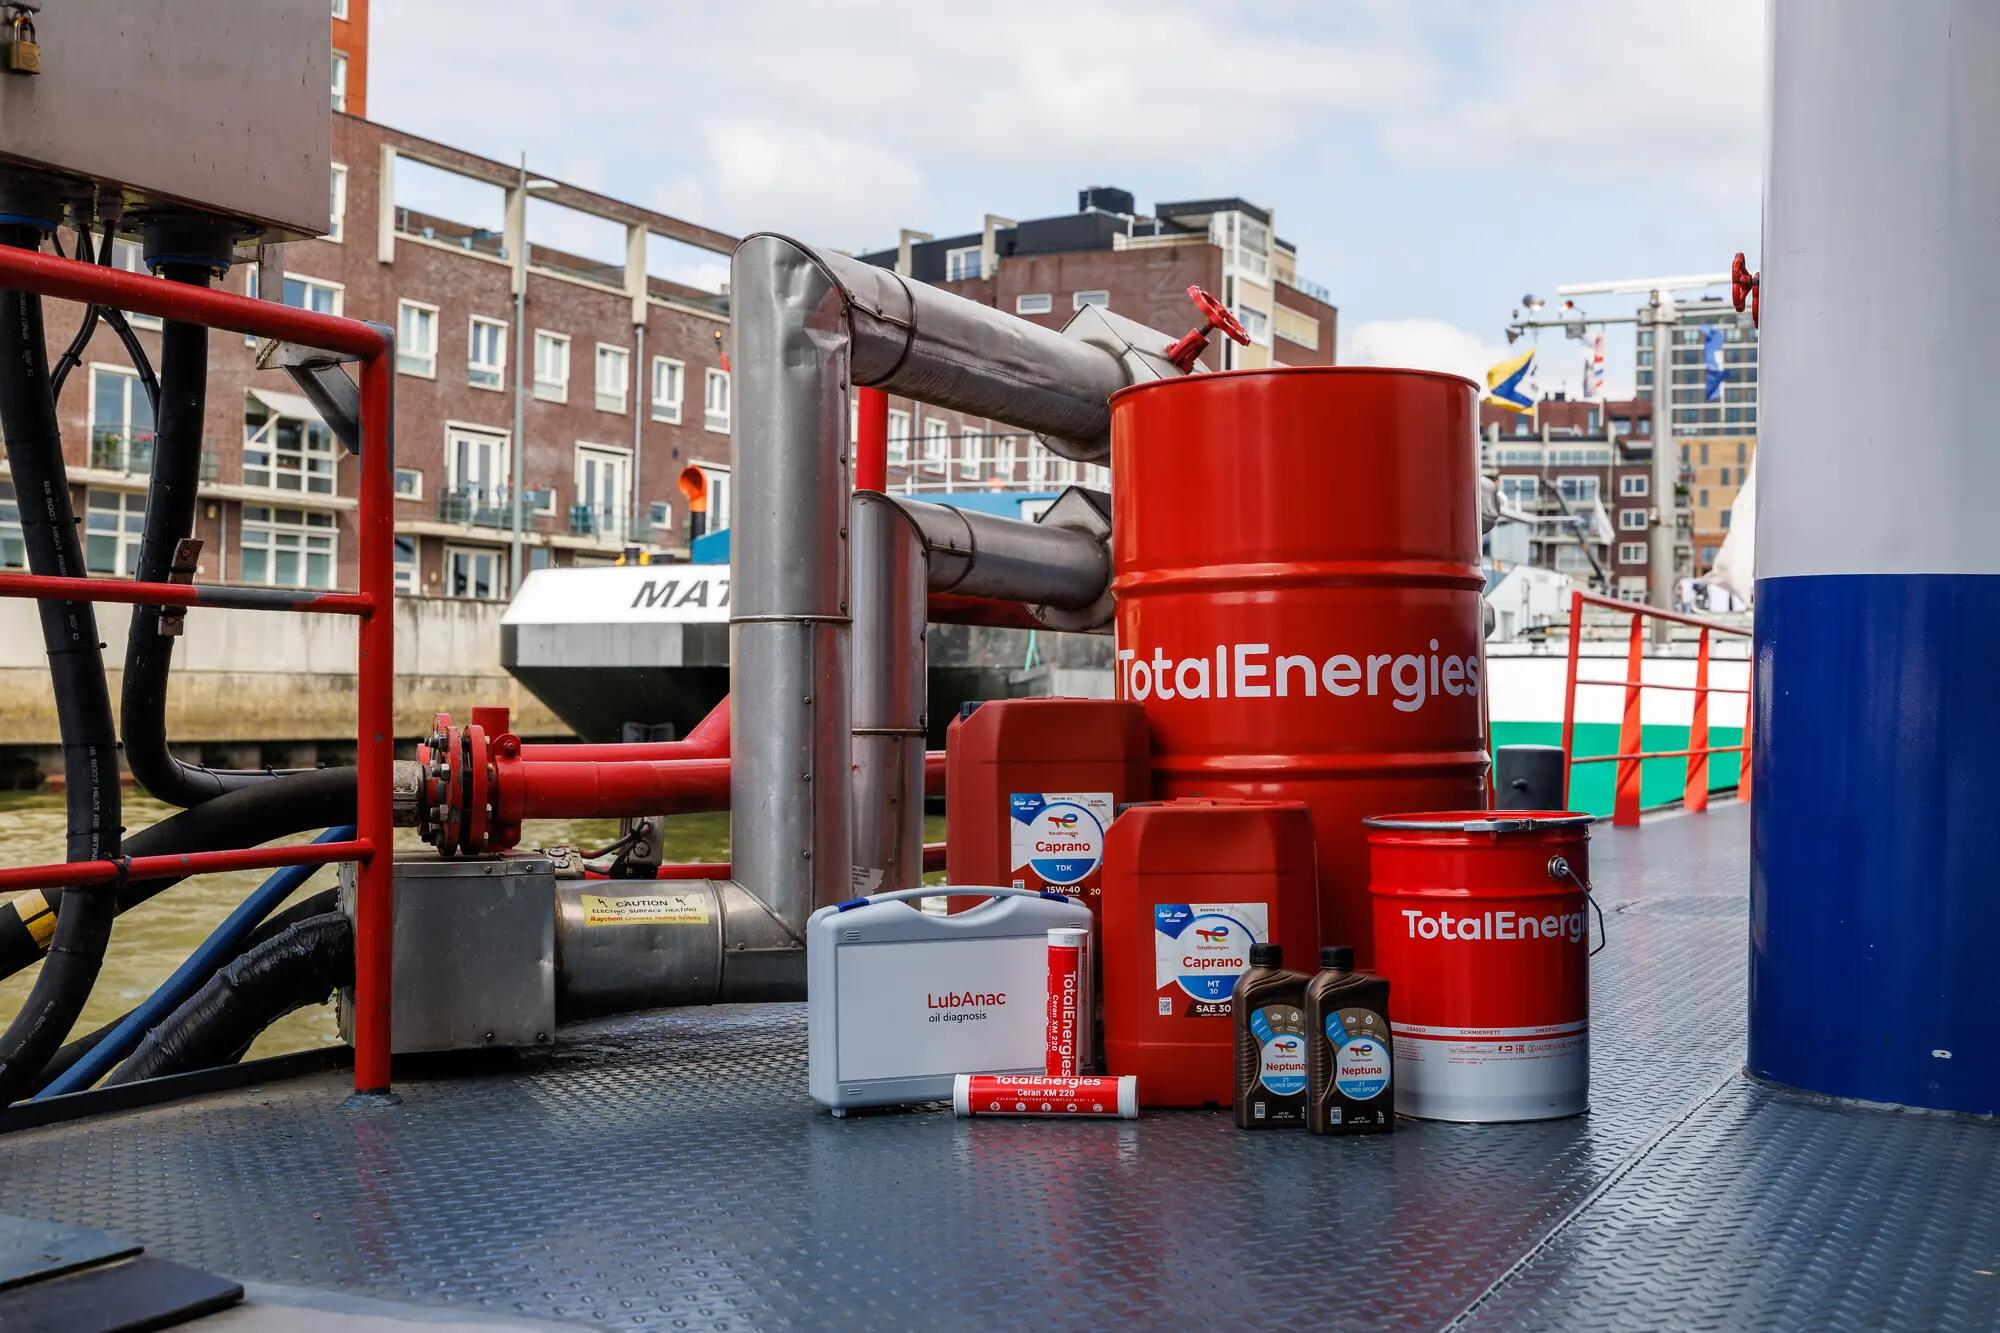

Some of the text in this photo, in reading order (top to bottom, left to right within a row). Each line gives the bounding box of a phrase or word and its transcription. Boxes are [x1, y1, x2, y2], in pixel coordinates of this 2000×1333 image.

[1119, 638, 1480, 712] TotalEnergies
[1036, 841, 1090, 853] Caprano
[1046, 886, 1080, 894] 15W-40
[616, 900, 668, 908] CAUTION
[1402, 904, 1589, 943] TotalEnergi
[1183, 956, 1243, 969] Caprano
[927, 991, 1006, 1008] LubAnac
[928, 1011, 987, 1023] oil diagnosis
[1052, 1021, 1058, 1033] XM
[1059, 970, 1076, 1077] TotalEnergies
[1266, 1063, 1305, 1072] Neptuna
[1342, 1066, 1382, 1076] Neptuna
[995, 1076, 1101, 1088] TotalEnergies
